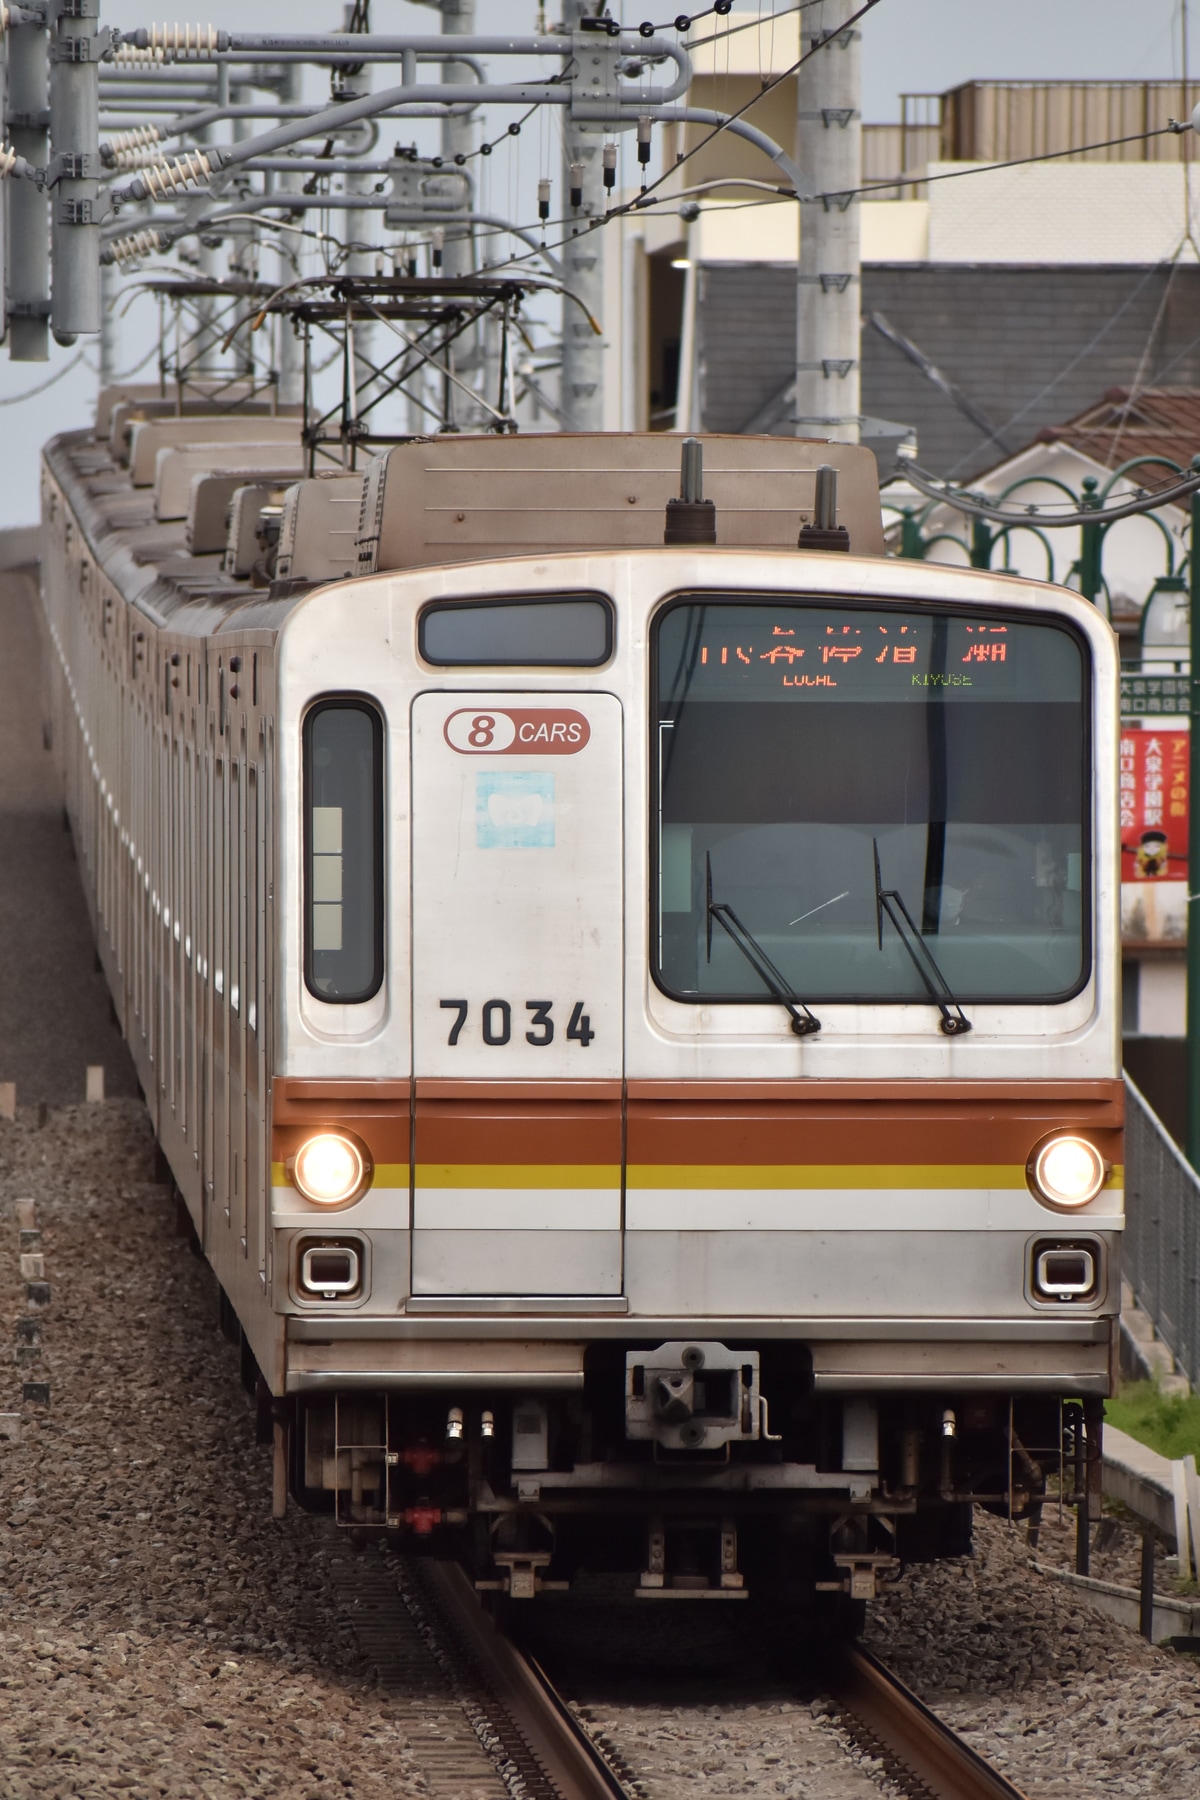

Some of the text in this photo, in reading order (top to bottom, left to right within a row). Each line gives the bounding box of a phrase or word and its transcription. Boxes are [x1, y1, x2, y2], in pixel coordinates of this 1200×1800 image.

[468, 715, 582, 747] 8 CARS
[1144, 738, 1163, 826] 大泉学園駅
[439, 1000, 595, 1047] 7034
